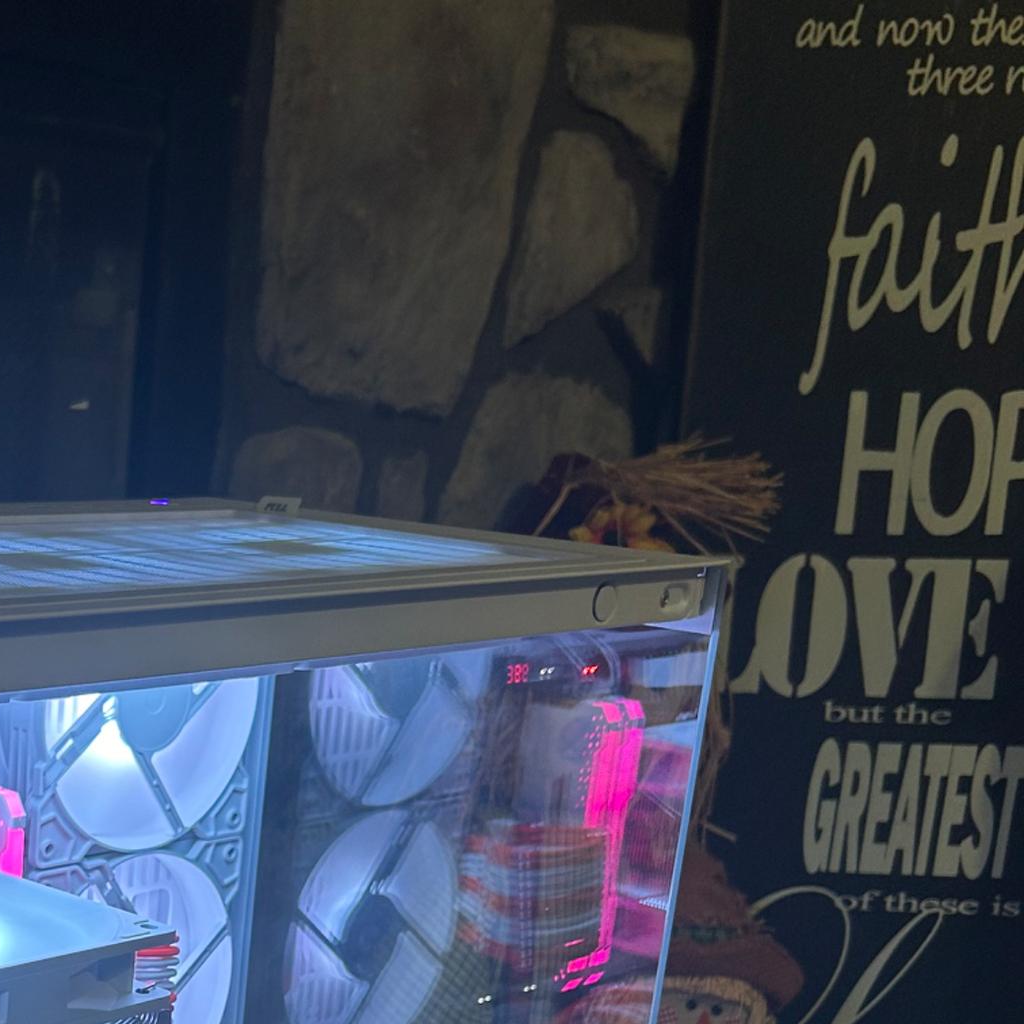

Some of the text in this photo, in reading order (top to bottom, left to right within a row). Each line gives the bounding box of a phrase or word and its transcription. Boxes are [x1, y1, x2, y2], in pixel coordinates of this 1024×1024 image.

[795, 3, 1024, 47] and now the
[907, 53, 994, 96] three
[834, 389, 1024, 536] HOP
[824, 701, 952, 726] but the
[803, 737, 1024, 880] GREATEST
[833, 889, 1020, 916] of these is
